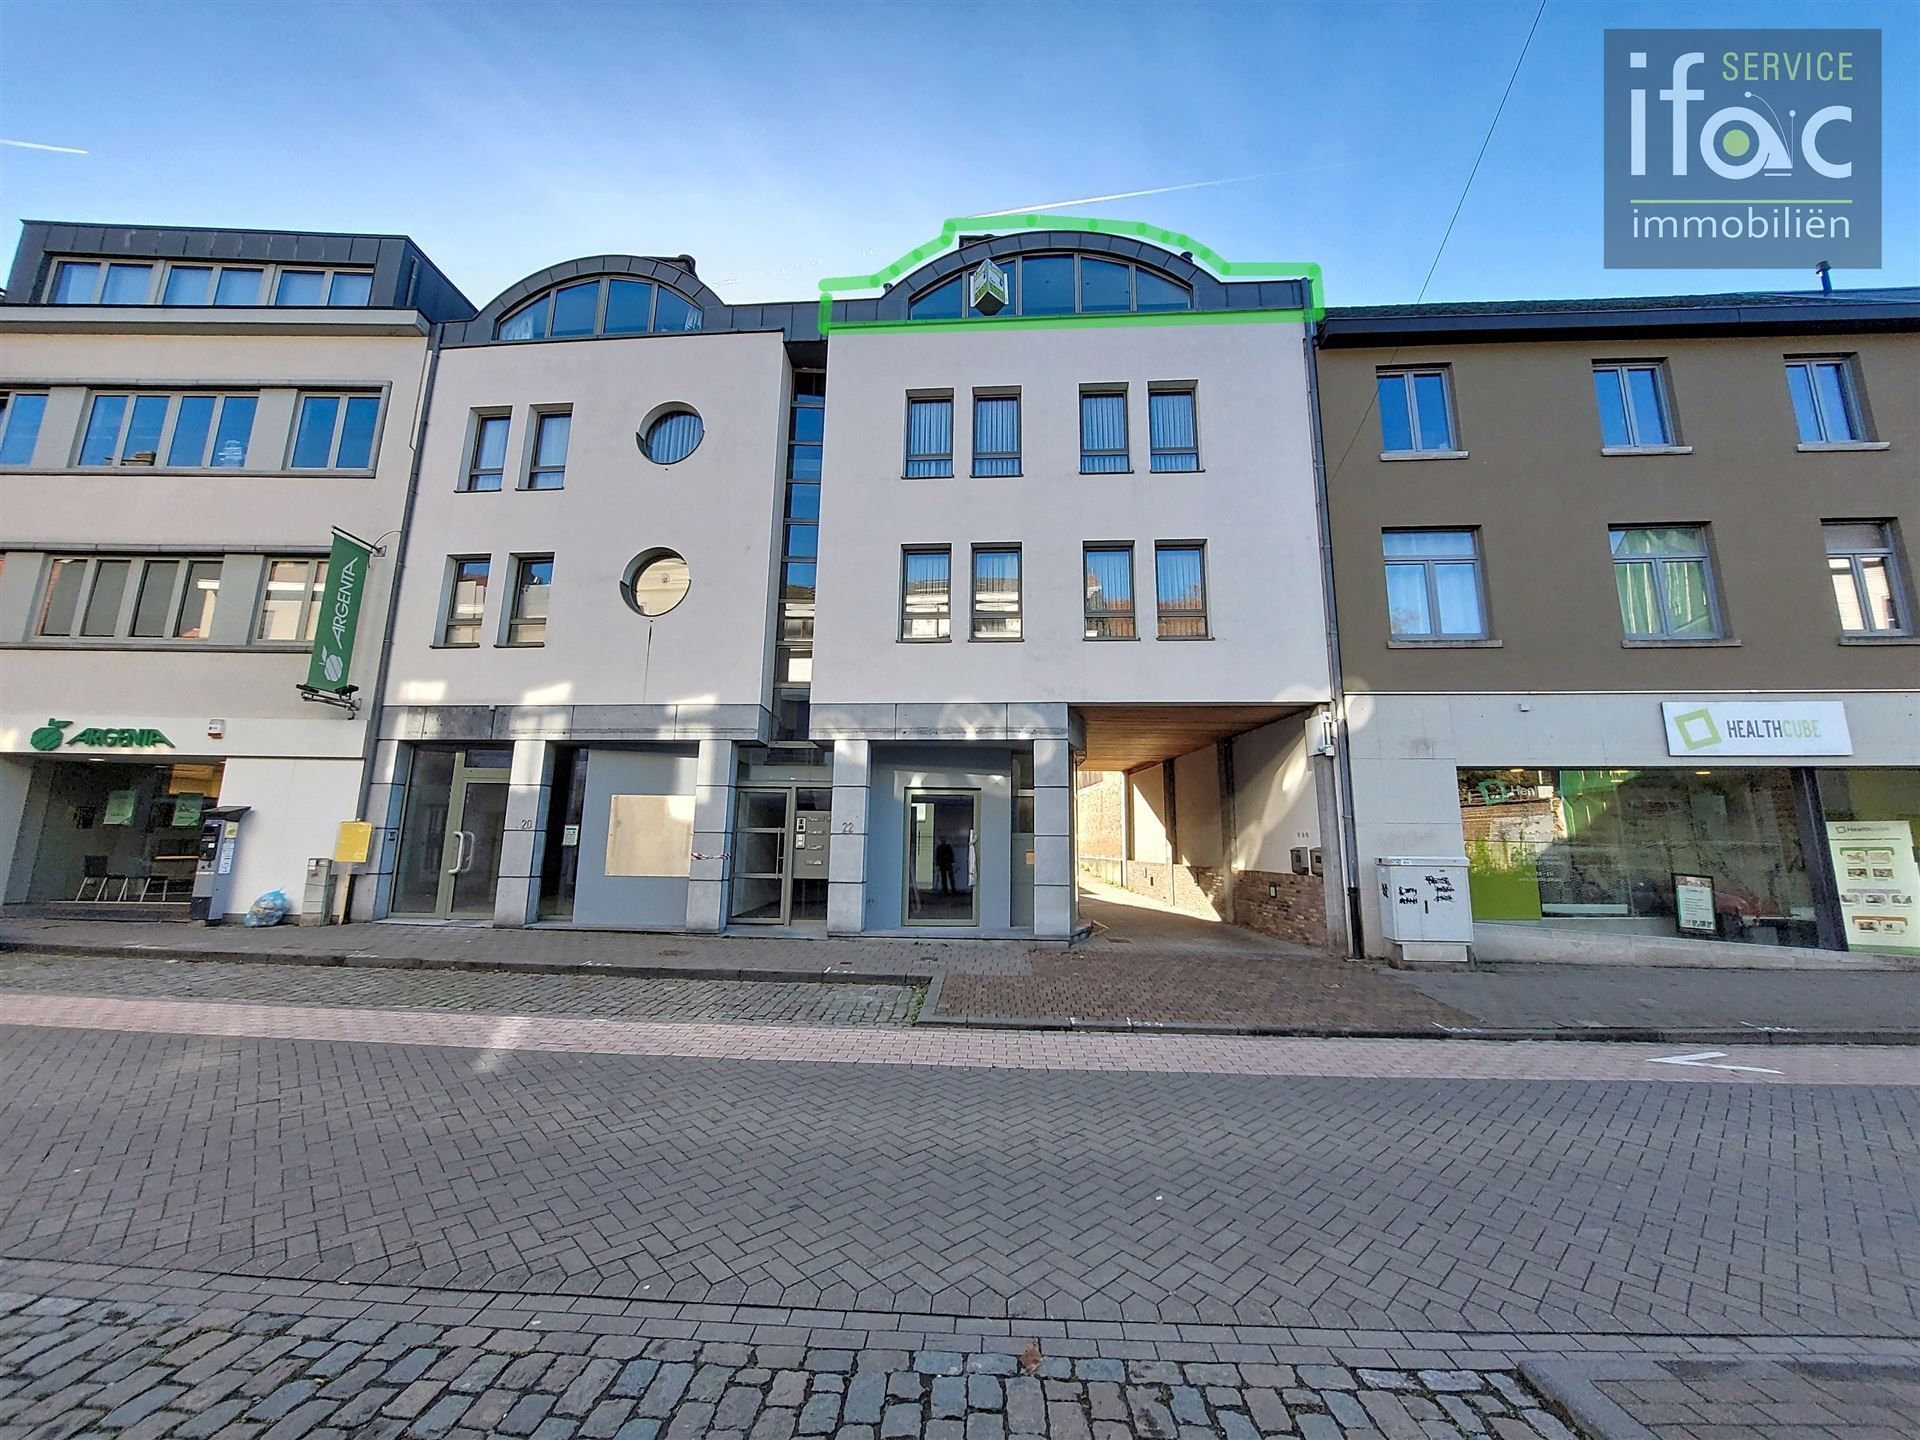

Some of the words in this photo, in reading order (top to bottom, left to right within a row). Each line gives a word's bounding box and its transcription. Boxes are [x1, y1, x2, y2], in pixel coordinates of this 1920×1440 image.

[331, 557, 358, 650] ARGENTA
[65, 728, 176, 748] ARGENTA
[1726, 719, 1821, 738] HEALTHCUBE
[521, 819, 533, 830] 20
[841, 822, 855, 833] 22
